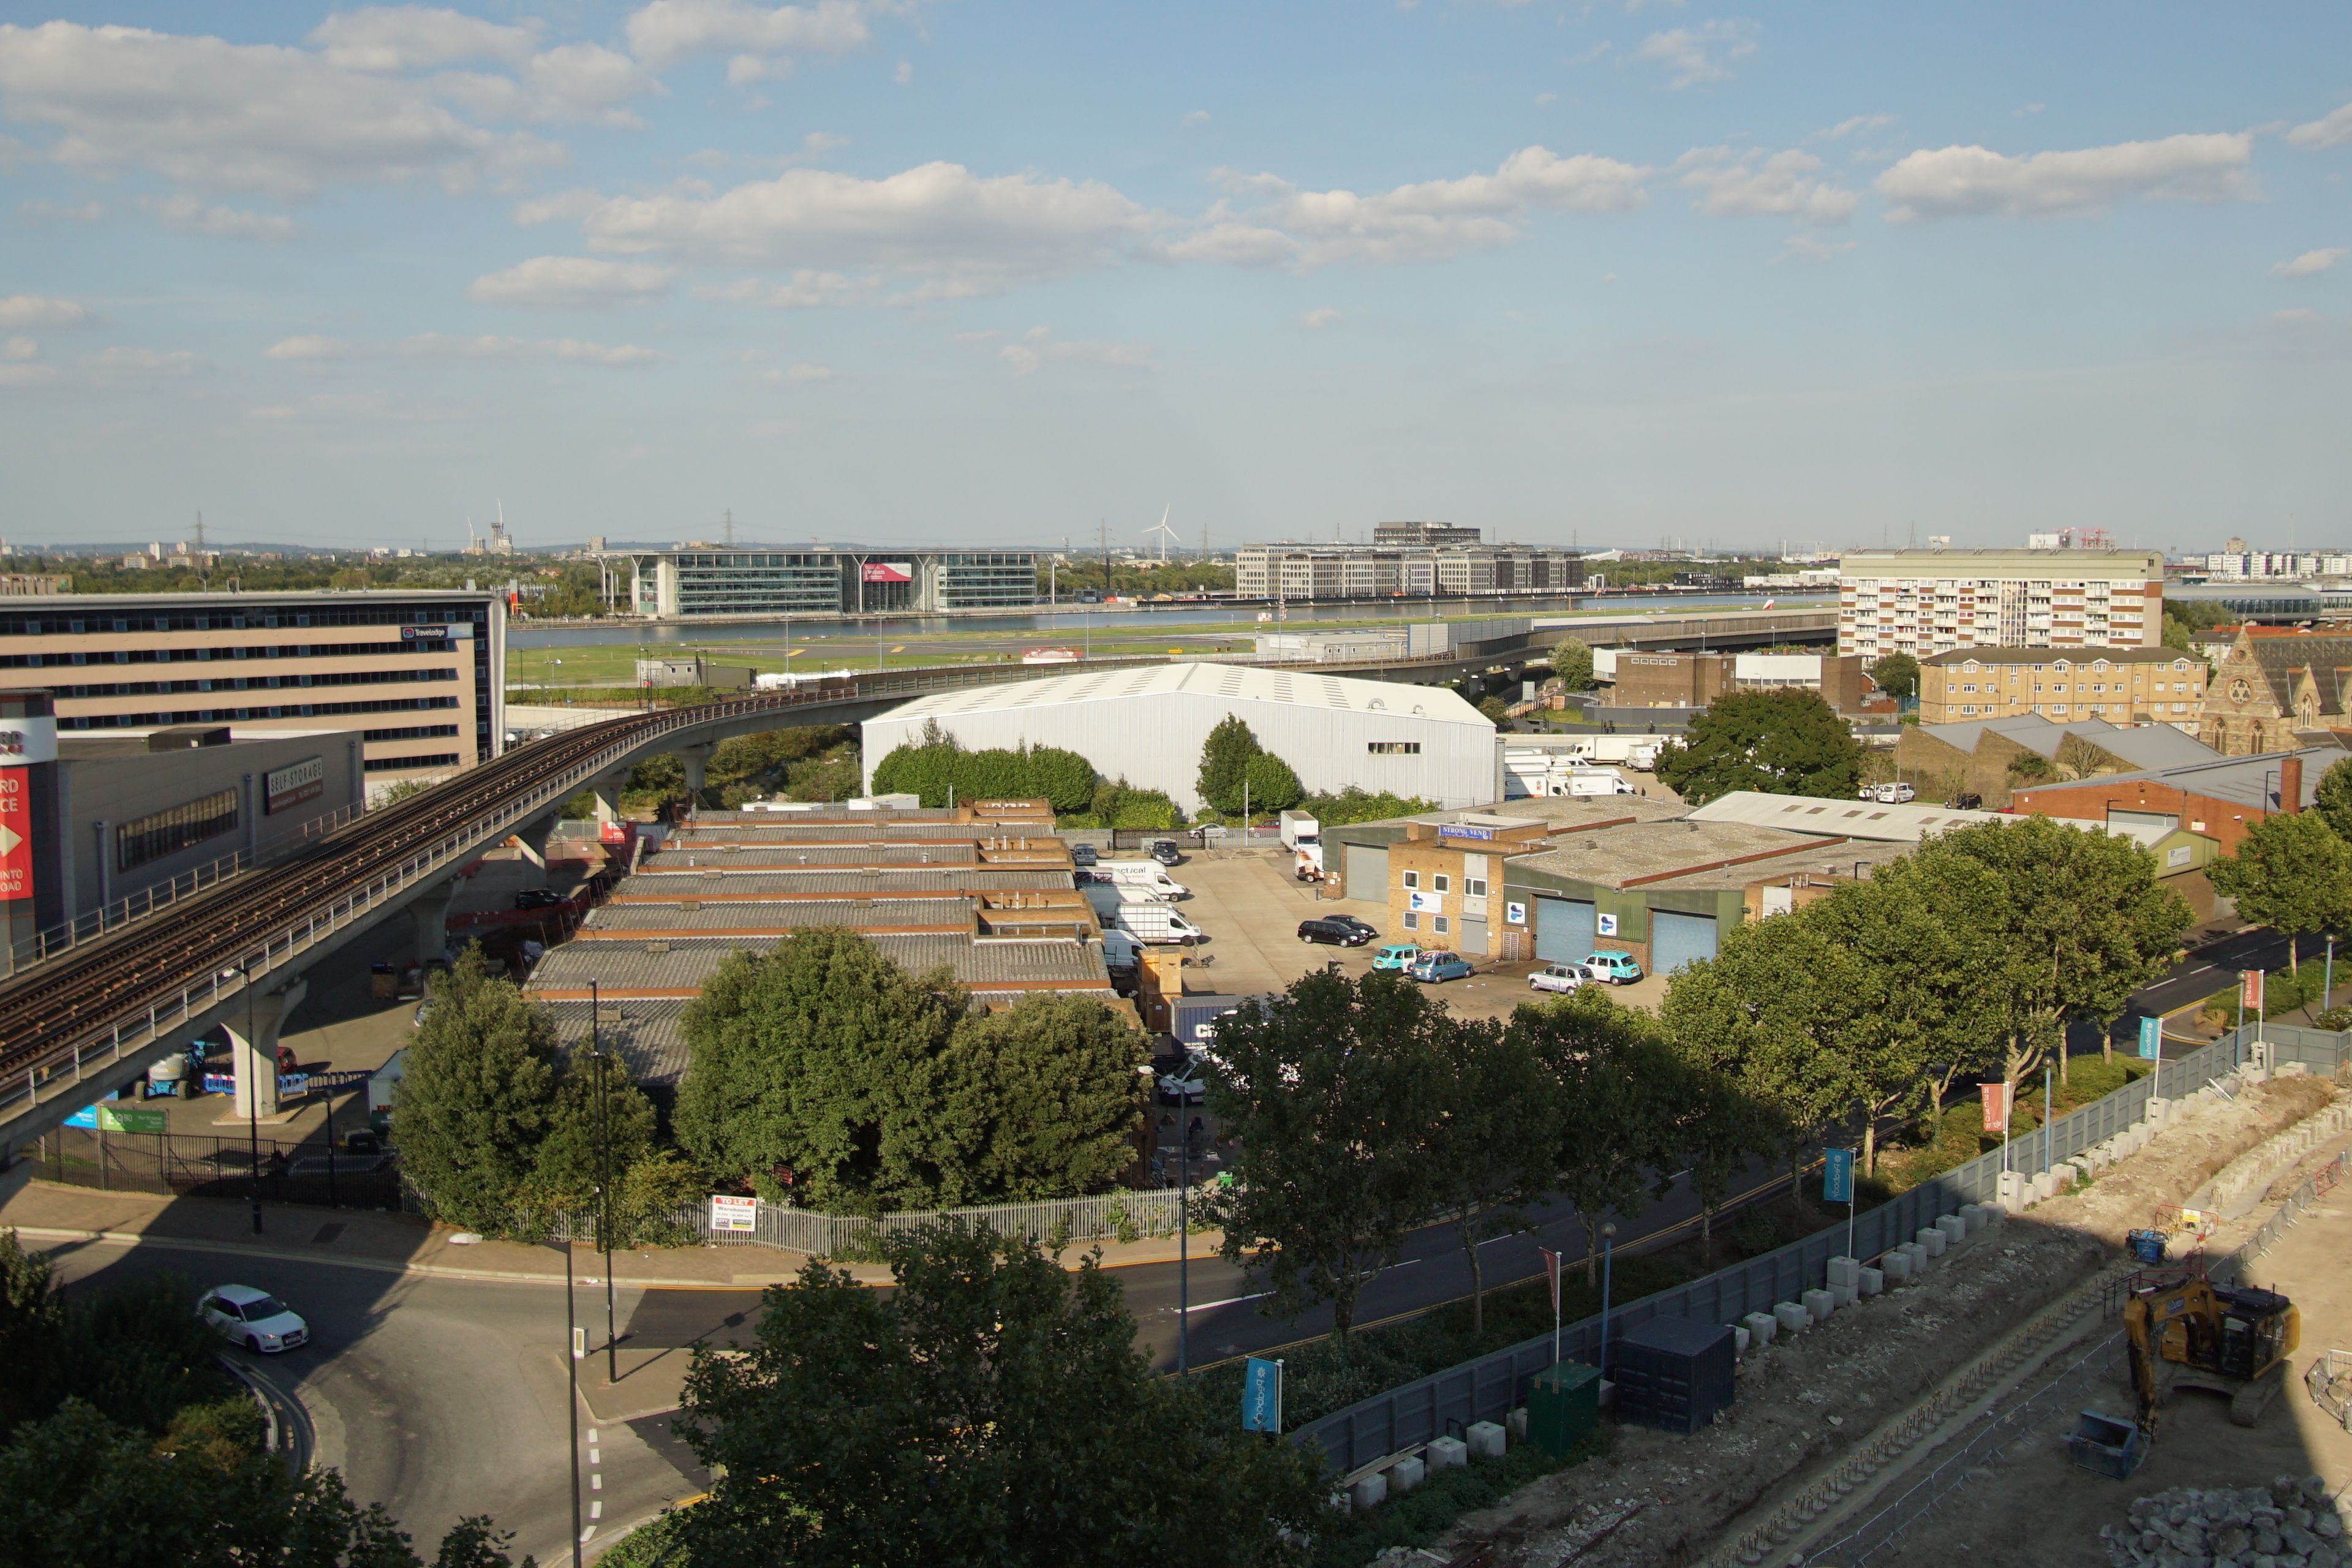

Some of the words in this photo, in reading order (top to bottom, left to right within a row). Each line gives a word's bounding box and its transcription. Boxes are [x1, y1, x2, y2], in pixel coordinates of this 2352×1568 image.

[415, 628, 445, 637] Travelodge
[271, 774, 287, 793] SELF
[290, 763, 322, 786] STORAGE
